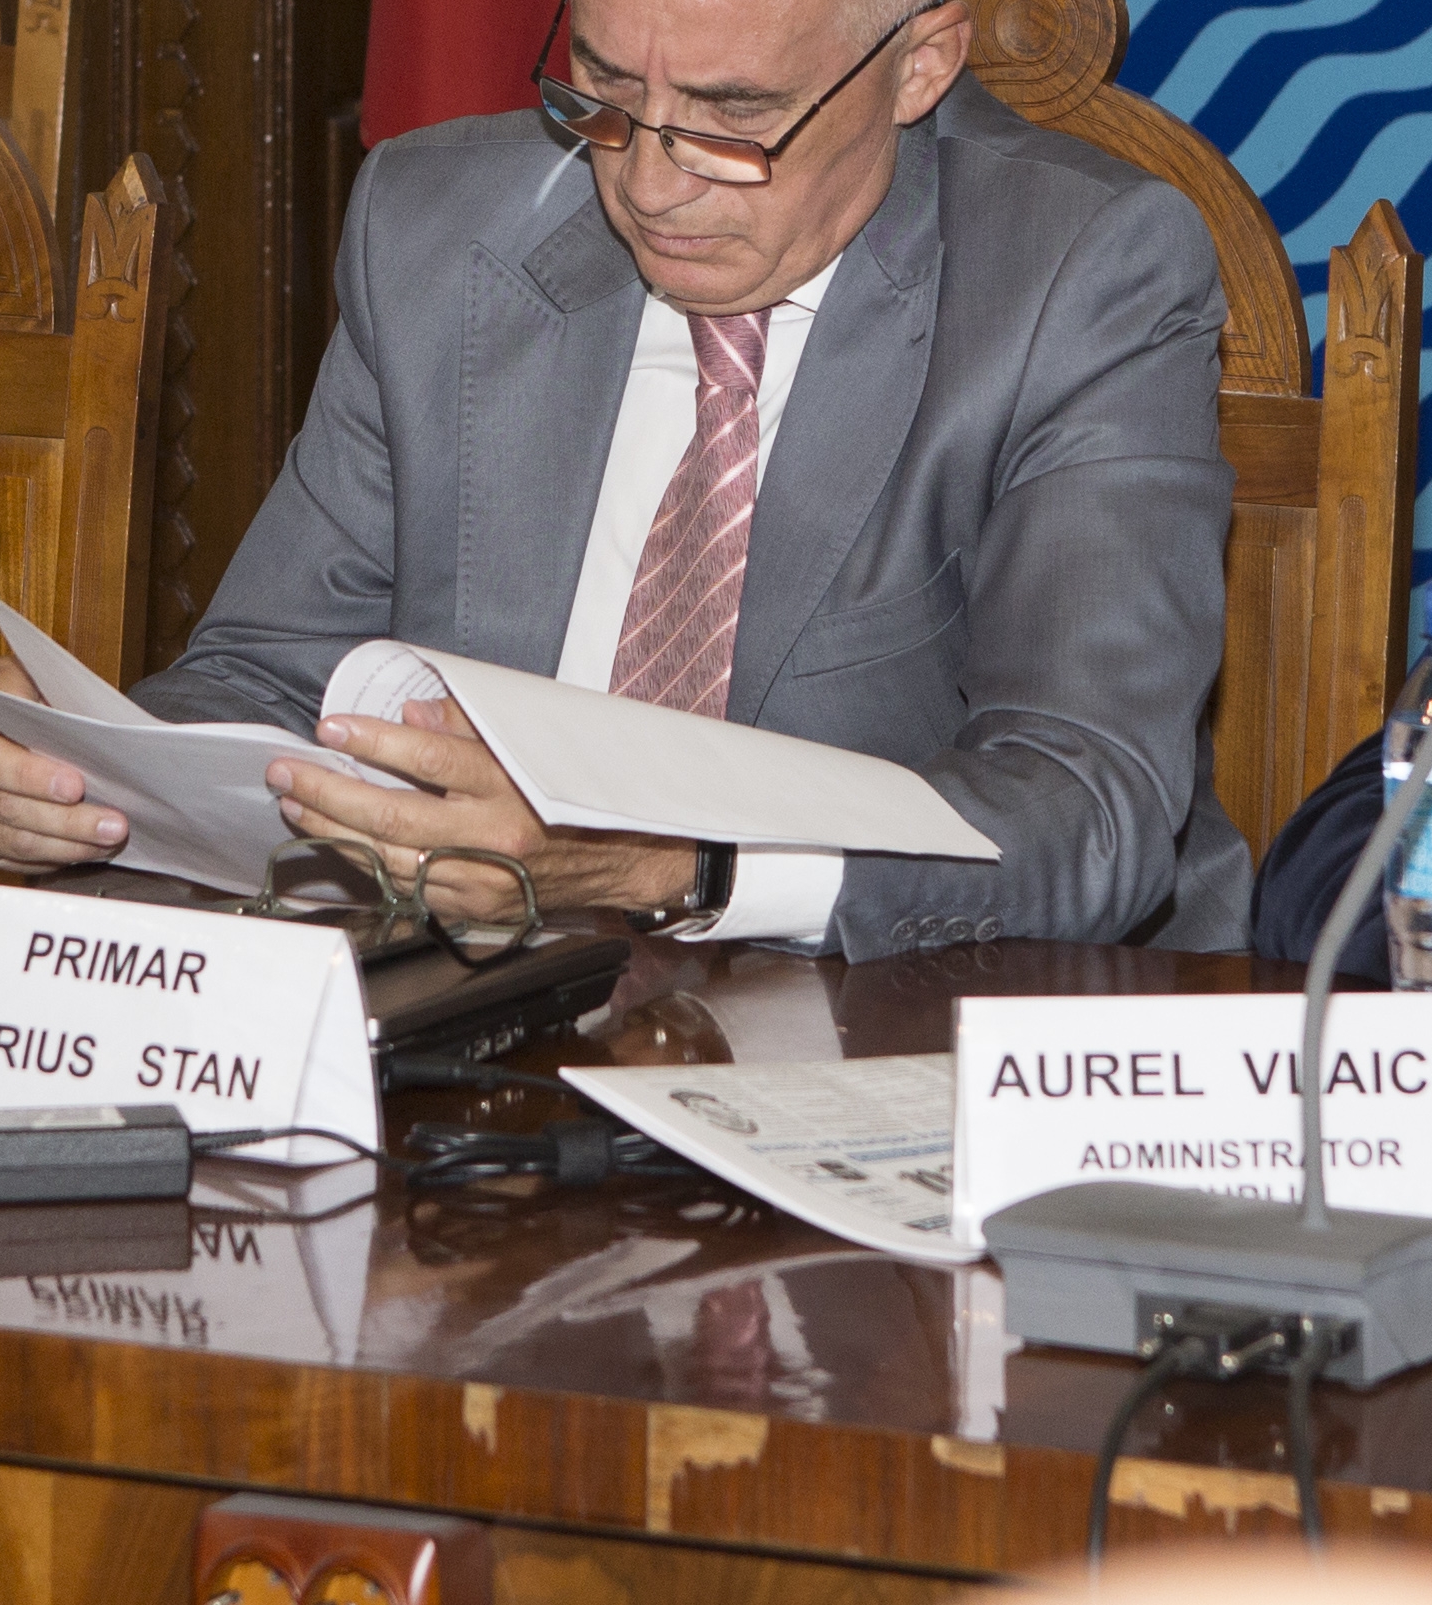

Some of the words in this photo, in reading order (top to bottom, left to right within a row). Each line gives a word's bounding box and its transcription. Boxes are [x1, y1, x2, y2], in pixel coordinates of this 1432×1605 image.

[23, 932, 206, 993] PRIMAR
[137, 1044, 260, 1100] STAN
[991, 1052, 1204, 1098] AUREL
[1079, 1139, 1402, 1170] ADMINISTRTOR
